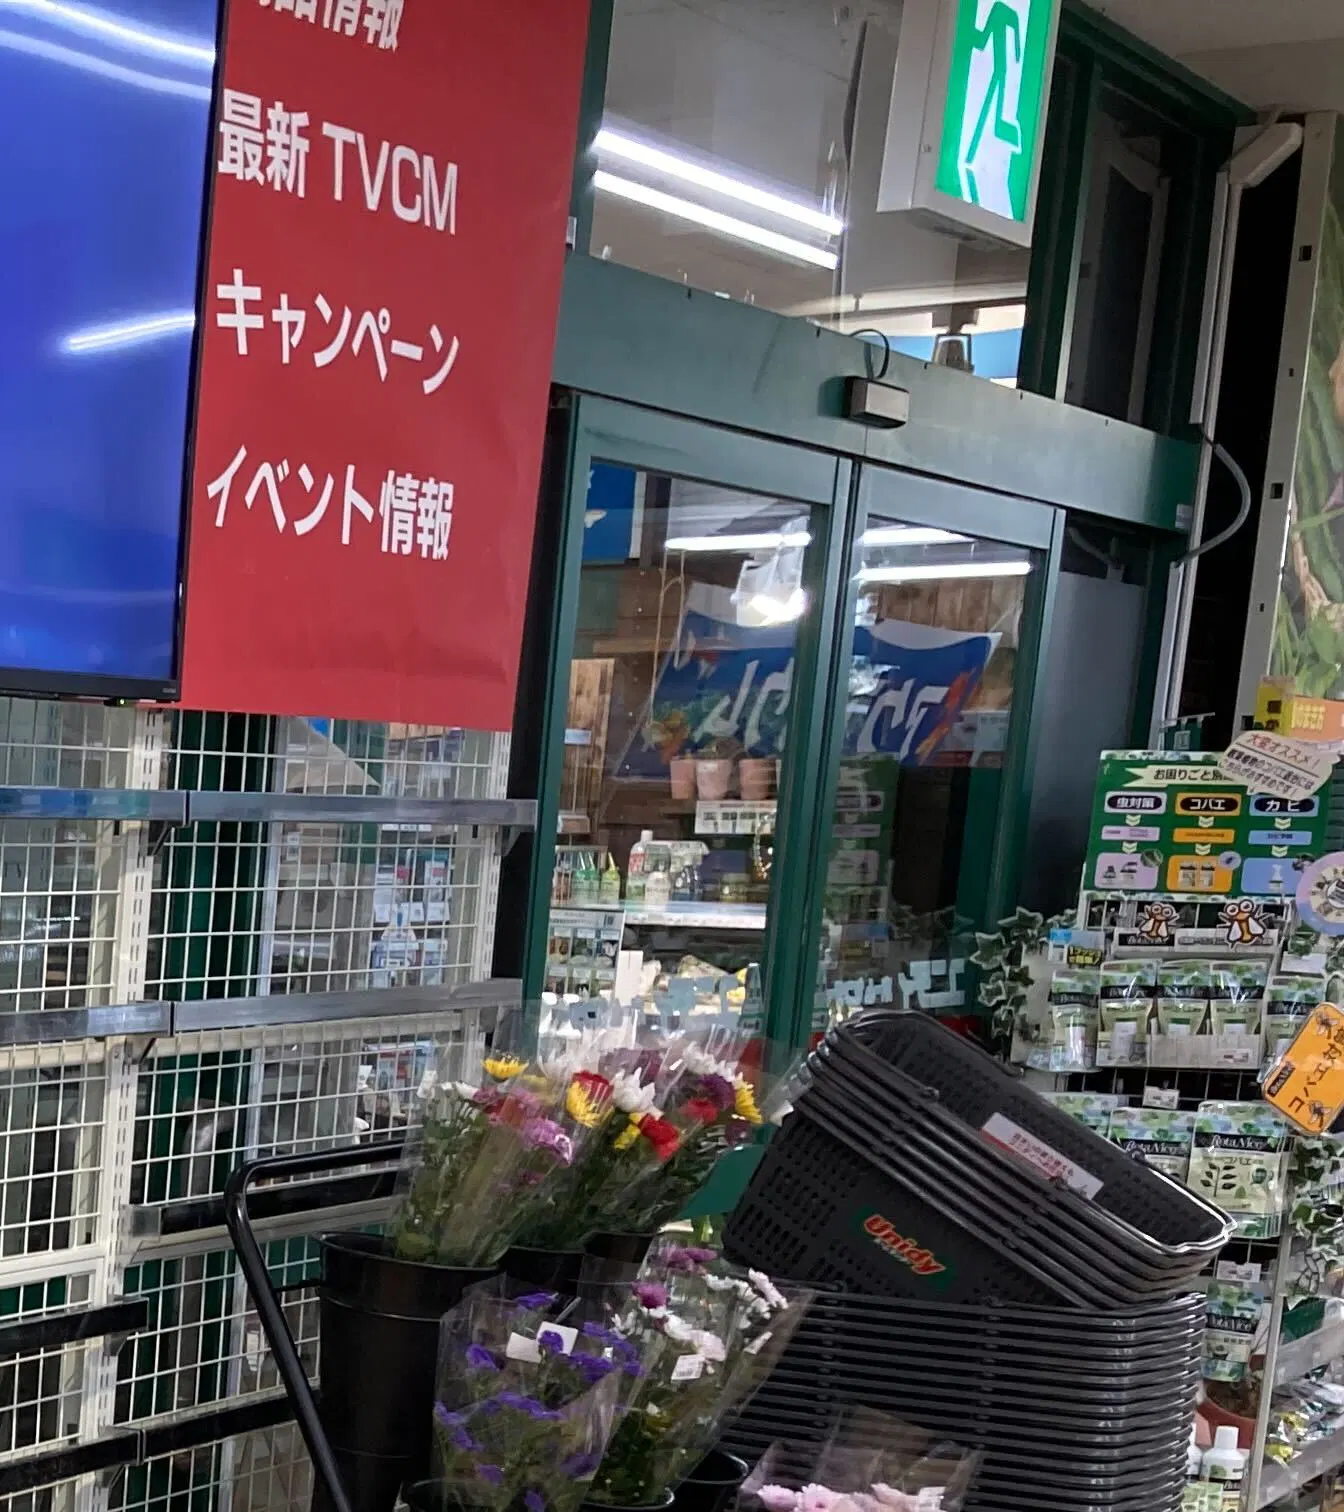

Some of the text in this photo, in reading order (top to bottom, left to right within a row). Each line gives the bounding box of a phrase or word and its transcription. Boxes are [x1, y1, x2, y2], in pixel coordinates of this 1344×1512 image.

[217, 88, 458, 236] 最新 TVCM
[216, 268, 460, 395] キャンペーン
[207, 444, 454, 561] イベント情報
[1189, 797, 1226, 811] コバエ
[864, 1214, 946, 1275] Unidy
